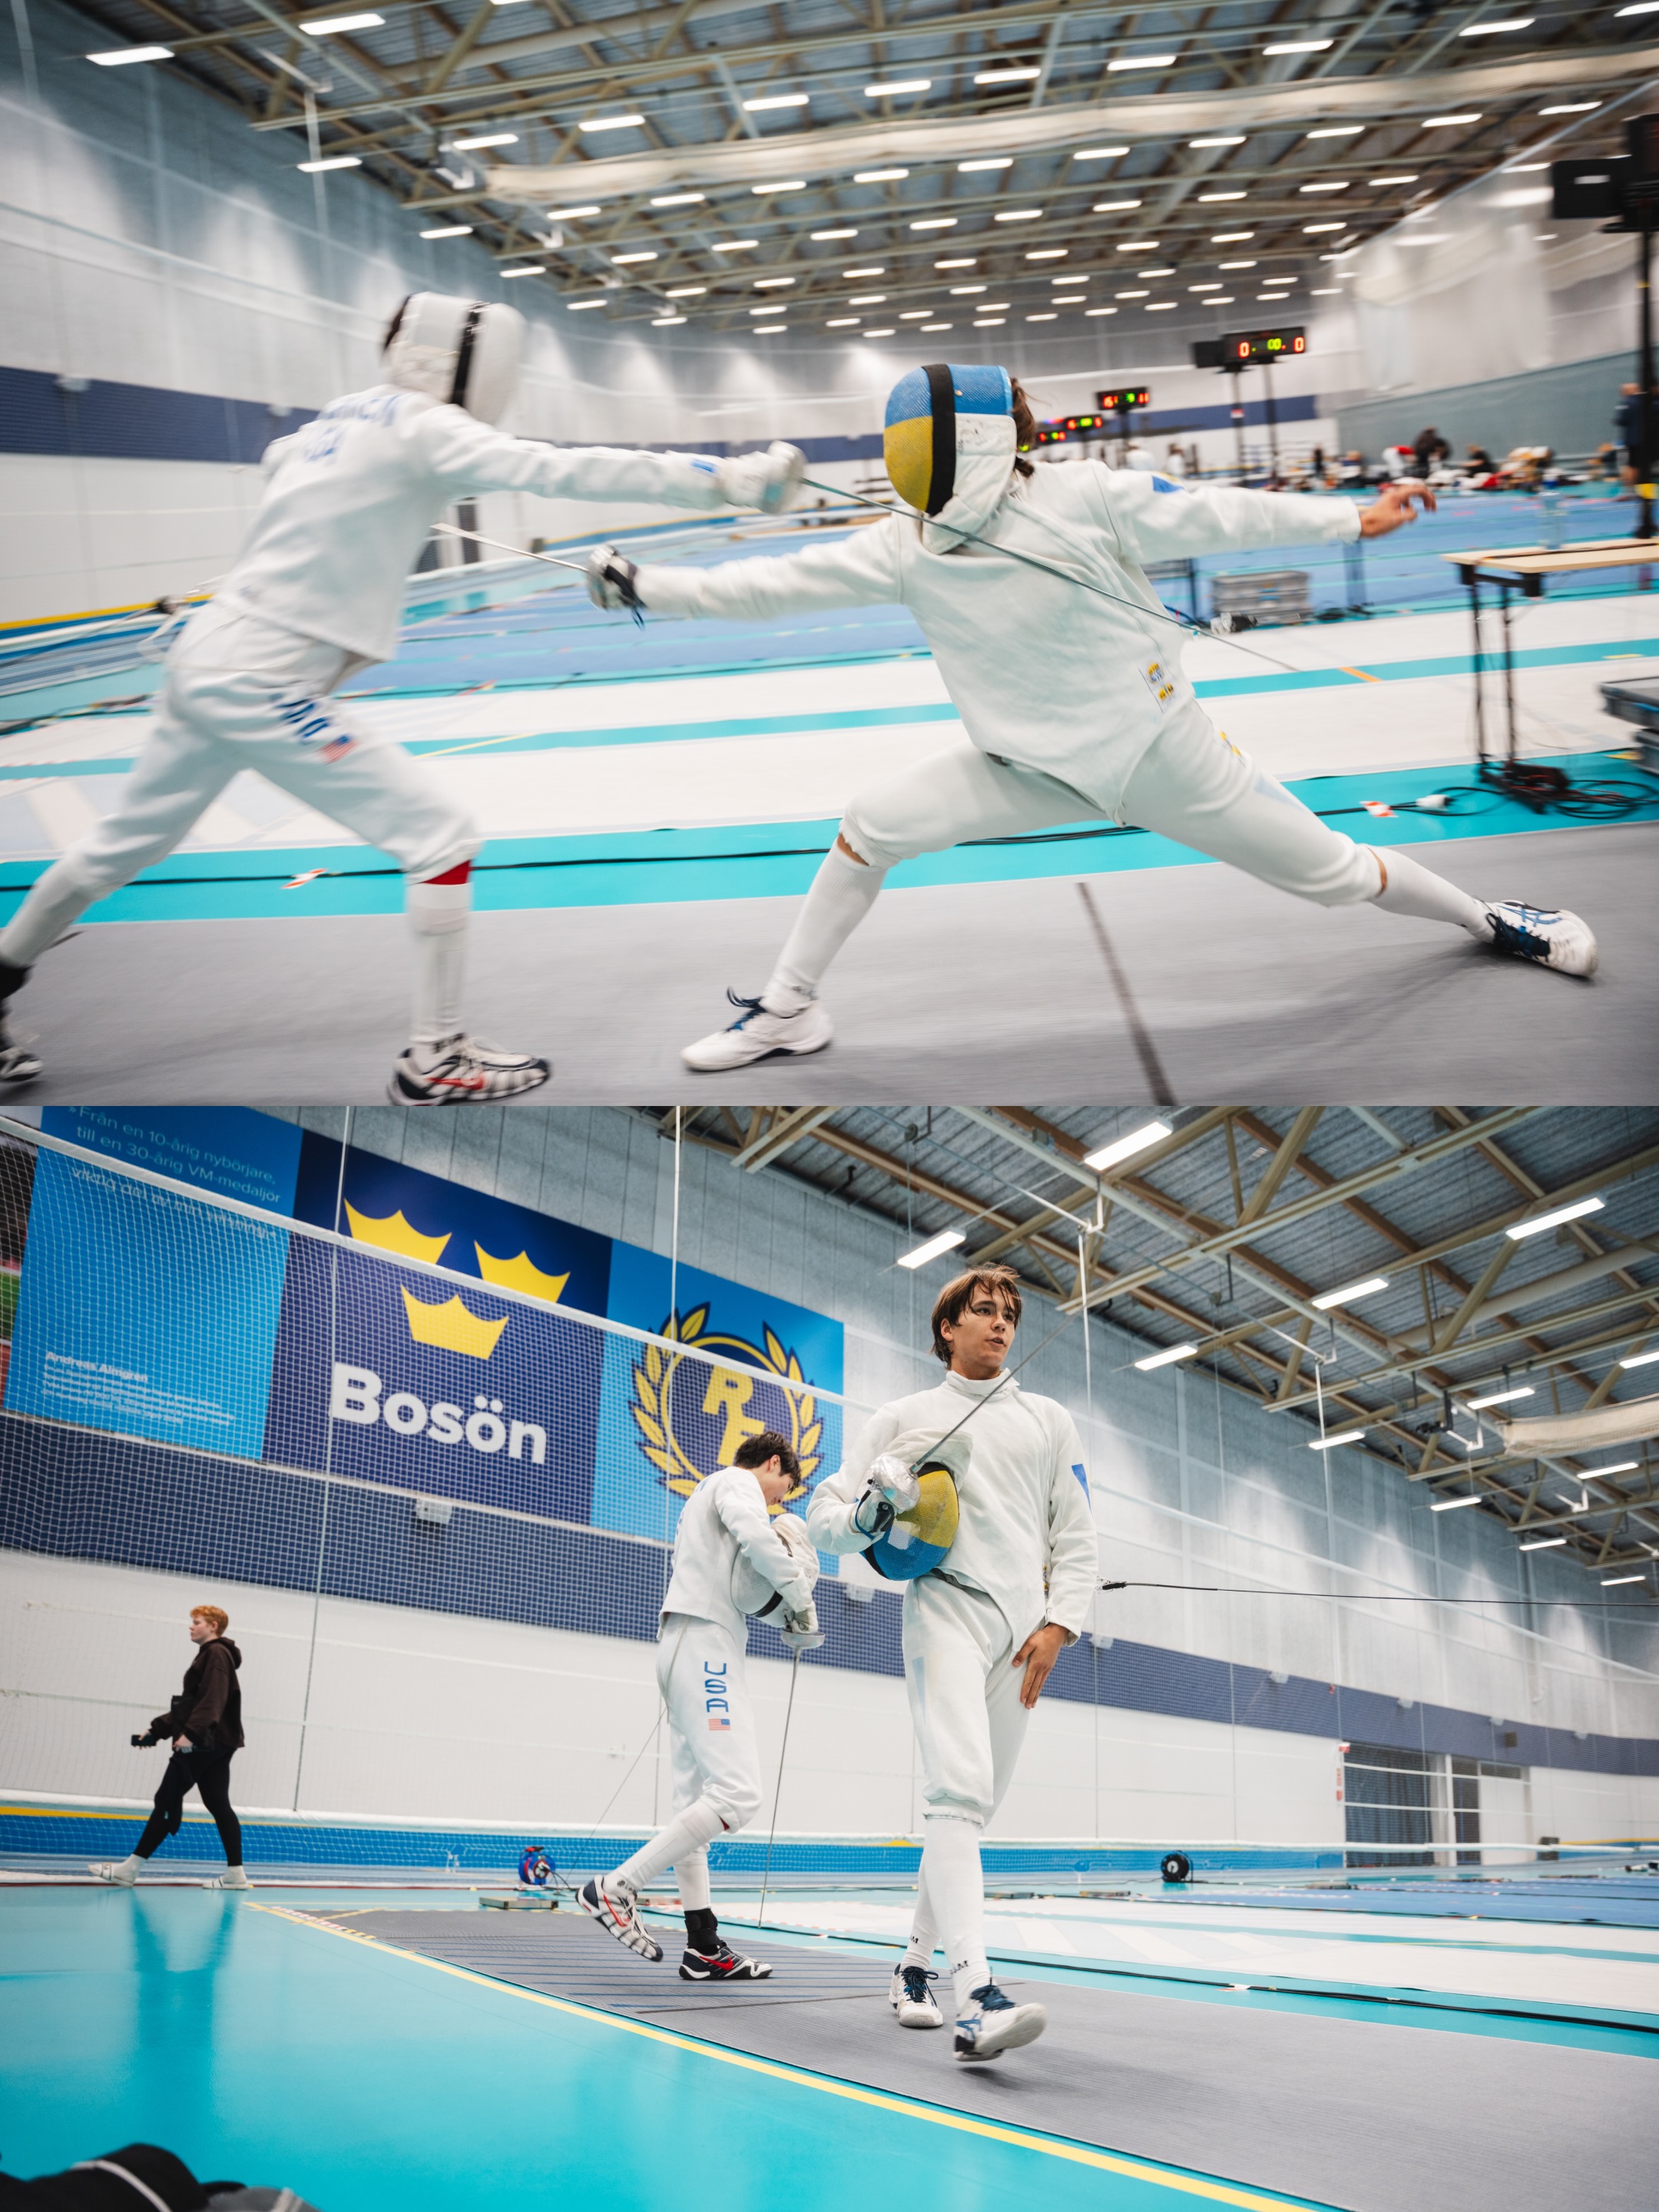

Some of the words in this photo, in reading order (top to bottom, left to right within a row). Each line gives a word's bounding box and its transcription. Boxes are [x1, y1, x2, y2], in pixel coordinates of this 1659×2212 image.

[77, 1126, 95, 1142] till
[101, 1137, 121, 1151] en
[127, 1142, 183, 1174] 30-årig
[188, 1162, 280, 1202] VM-medaljör
[123, 1124, 144, 1138] en
[150, 1131, 200, 1161] 10-årig
[204, 1152, 275, 1184] nybörjare,
[46, 1352, 97, 1373] Andreas
[330, 1362, 547, 1465] Bosön
[704, 1661, 729, 1712] USA
